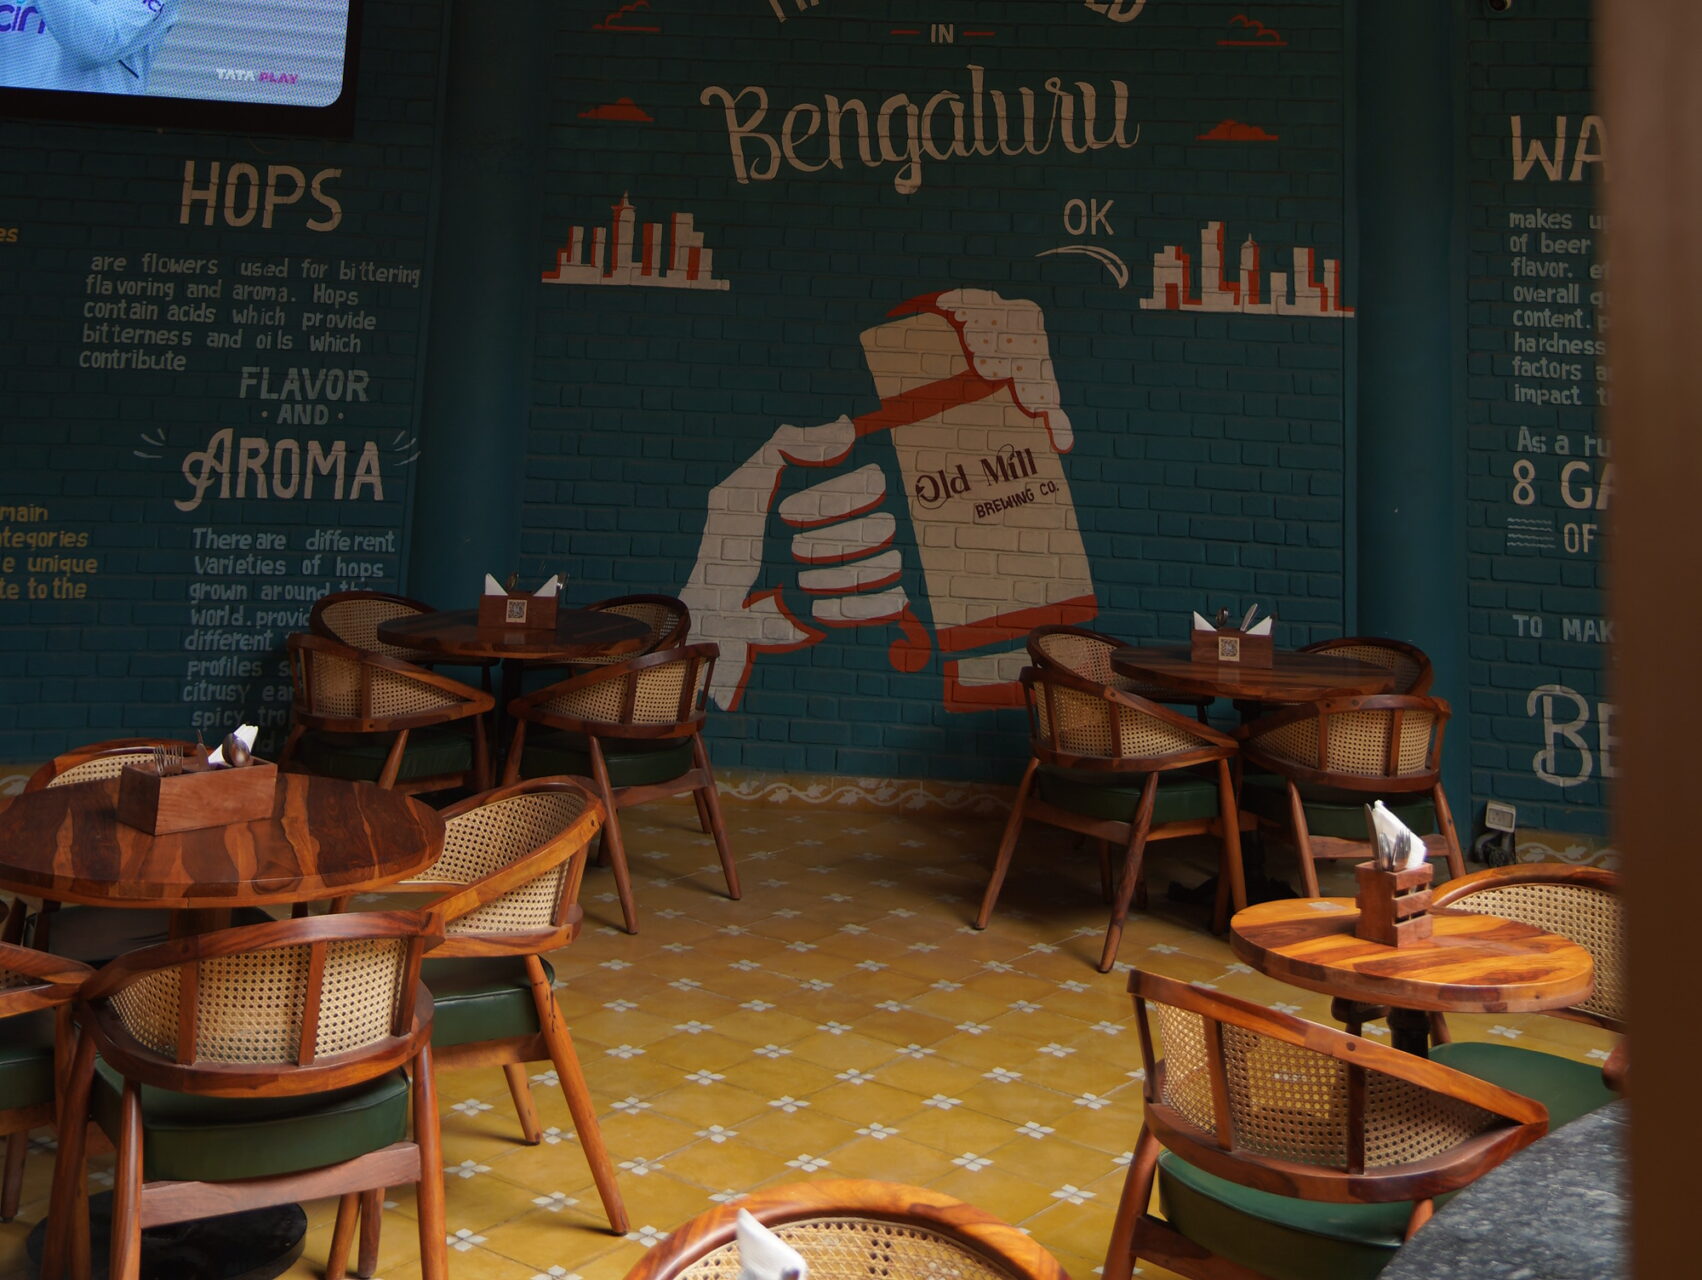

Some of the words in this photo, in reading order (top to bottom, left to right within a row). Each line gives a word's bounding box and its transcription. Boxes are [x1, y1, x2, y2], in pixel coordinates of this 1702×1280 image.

[930, 23, 954, 44] IN
[216, 68, 255, 81] TATA
[699, 63, 1141, 196] Bengaluru
[179, 160, 343, 232] HOPS
[1063, 198, 1115, 236] OK
[1509, 208, 1572, 230] makes
[1540, 231, 1591, 255] beer
[90, 255, 127, 272] are
[141, 253, 219, 275] flowers
[240, 258, 289, 278] used
[302, 259, 329, 279] for
[339, 261, 421, 289] bittering
[1511, 257, 1574, 279] flavor.
[85, 275, 175, 300] flavoring
[186, 279, 222, 298] and
[232, 285, 297, 303] aroma.
[313, 284, 359, 308] Hops
[1513, 283, 1579, 305] overall
[83, 300, 158, 321] contain
[167, 302, 216, 323] acids
[232, 306, 286, 327] which
[302, 310, 377, 332] provide
[1512, 308, 1591, 329] content.
[82, 323, 193, 346] bitterness
[206, 330, 242, 349] and
[256, 331, 293, 350] oils
[309, 333, 362, 354] which
[1514, 332, 1606, 356] hardness
[78, 348, 187, 371] contribute
[1512, 355, 1582, 381] factors
[239, 366, 371, 402] FLAVOR
[1514, 384, 1583, 406] impact
[276, 404, 329, 425] AND
[1517, 426, 1546, 454] As
[1554, 436, 1570, 456] a
[173, 427, 384, 512] AROMA
[916, 464, 971, 510] Old
[980, 444, 1038, 487] Mill
[1512, 459, 1536, 506] 8
[975, 488, 1035, 519] BREWING
[1039, 480, 1060, 497] CO.
[0, 526, 88, 551] tegories
[192, 527, 252, 550] There
[256, 532, 287, 551] are
[305, 528, 396, 553] different
[1563, 523, 1598, 553] OF
[27, 555, 98, 576] unique
[302, 554, 322, 575] of
[335, 557, 385, 582] hops
[27, 578, 48, 599] to
[52, 577, 87, 600] the
[189, 583, 248, 604] grown
[260, 582, 330, 601] around
[1512, 614, 1543, 638] TO
[184, 630, 273, 651] different
[187, 656, 263, 680] profiles
[183, 681, 250, 703] citrusy
